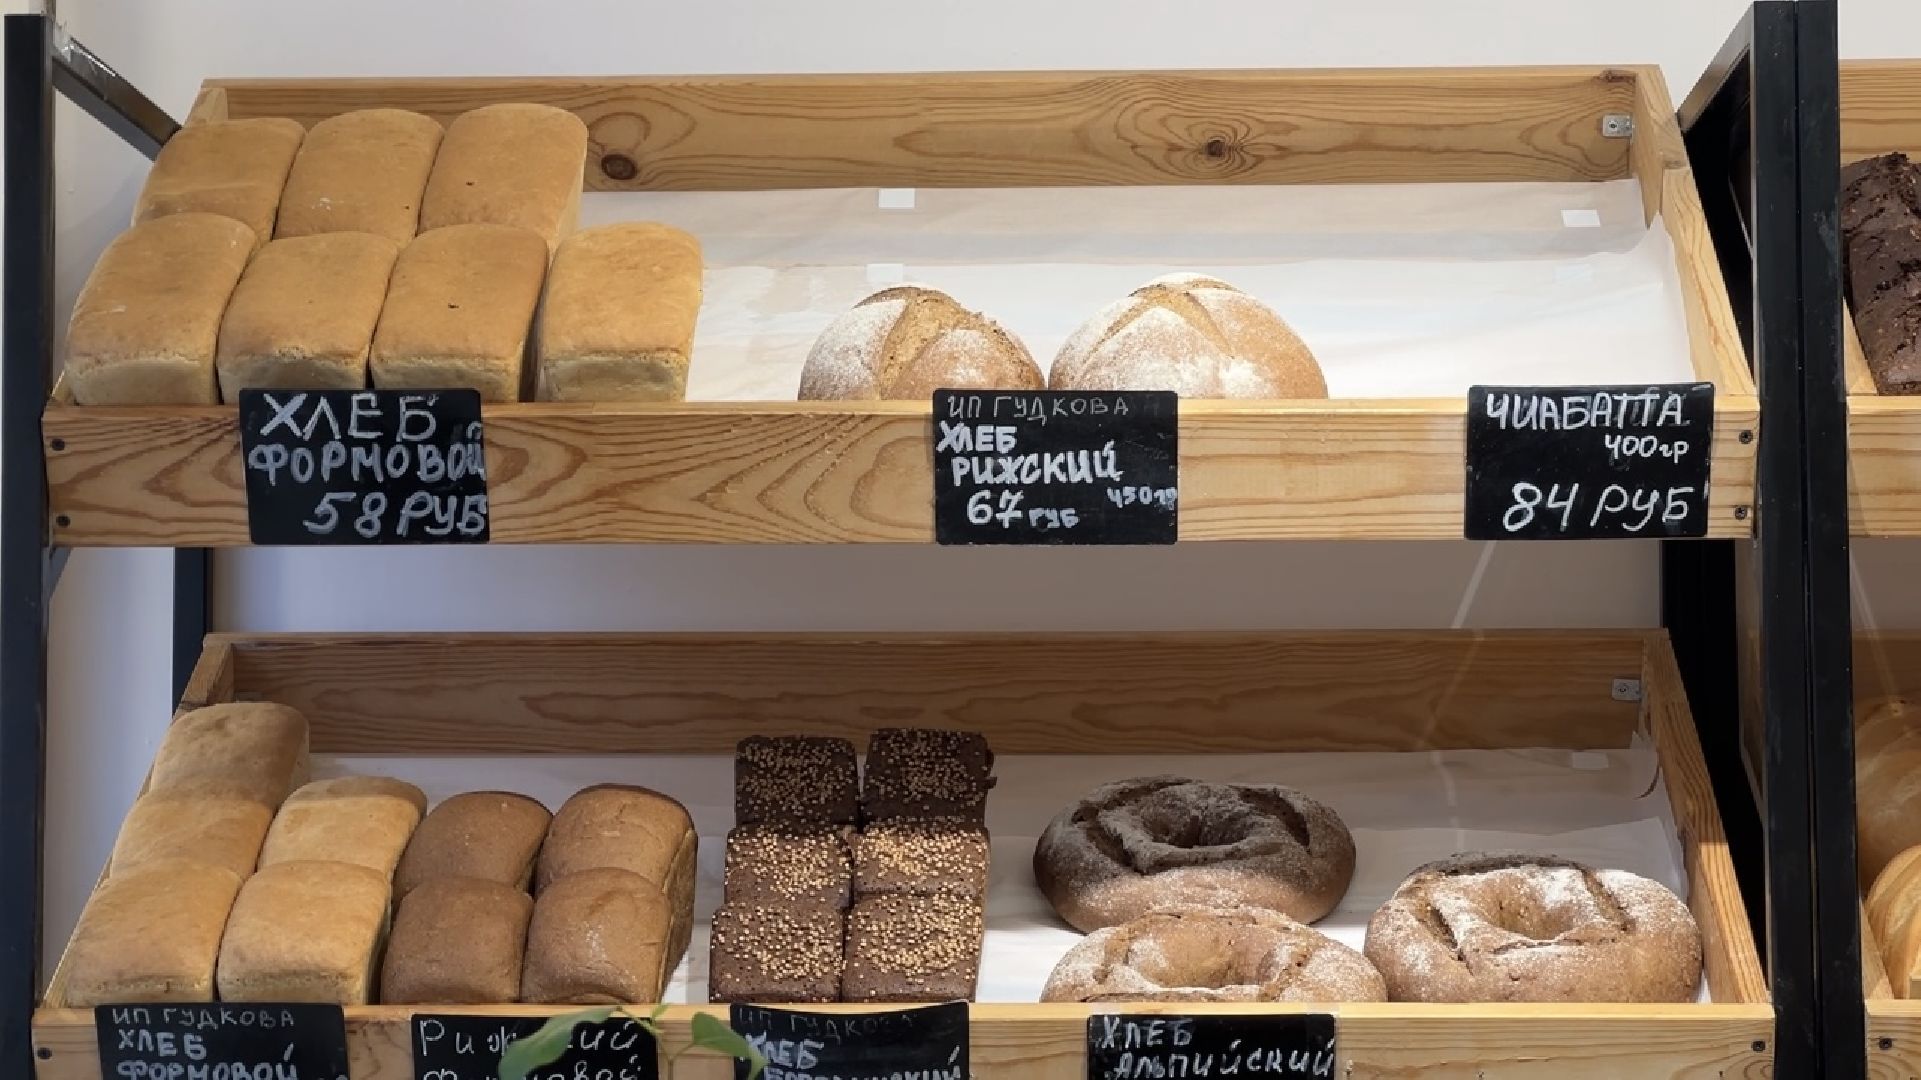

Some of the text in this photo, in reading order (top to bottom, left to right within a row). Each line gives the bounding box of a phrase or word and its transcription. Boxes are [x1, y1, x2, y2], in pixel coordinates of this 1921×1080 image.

[259, 393, 439, 442] ХЛЕБ
[948, 396, 1129, 426] ИП ГУДКОВА
[1486, 392, 1687, 431] ЧИАБАТТА
[248, 421, 487, 486] ФОРМОВОЙ
[936, 420, 1018, 453] ХЛЕБ
[1604, 434, 1690, 464] 400гр
[951, 439, 1124, 487] РИЖСКИЙ
[302, 490, 488, 538] 58 РУБ
[966, 489, 1024, 528] 67
[1501, 482, 1695, 533] 84 РУБ
[112, 1007, 295, 1030] ИП ГУДКОВА
[1101, 1015, 1194, 1049] ХЛЕБ
[118, 1029, 208, 1061] ХЛЕБ
[745, 1031, 825, 1070] ХЛЕБ
